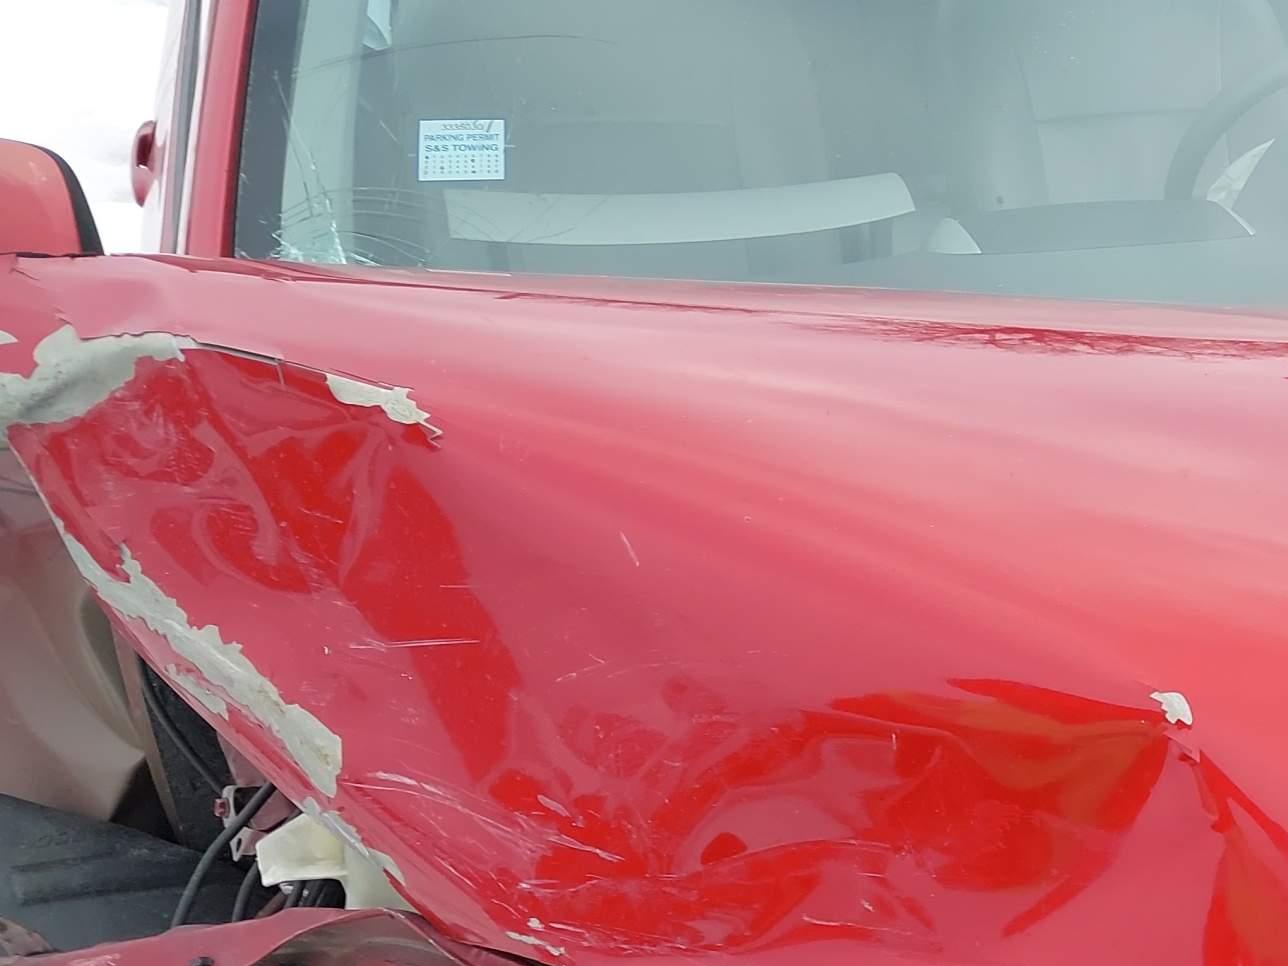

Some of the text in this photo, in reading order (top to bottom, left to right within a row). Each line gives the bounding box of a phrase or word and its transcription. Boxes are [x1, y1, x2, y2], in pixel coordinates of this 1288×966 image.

[424, 133, 500, 142] PARKING PERMIT
[425, 143, 499, 153] S&S TOWING
